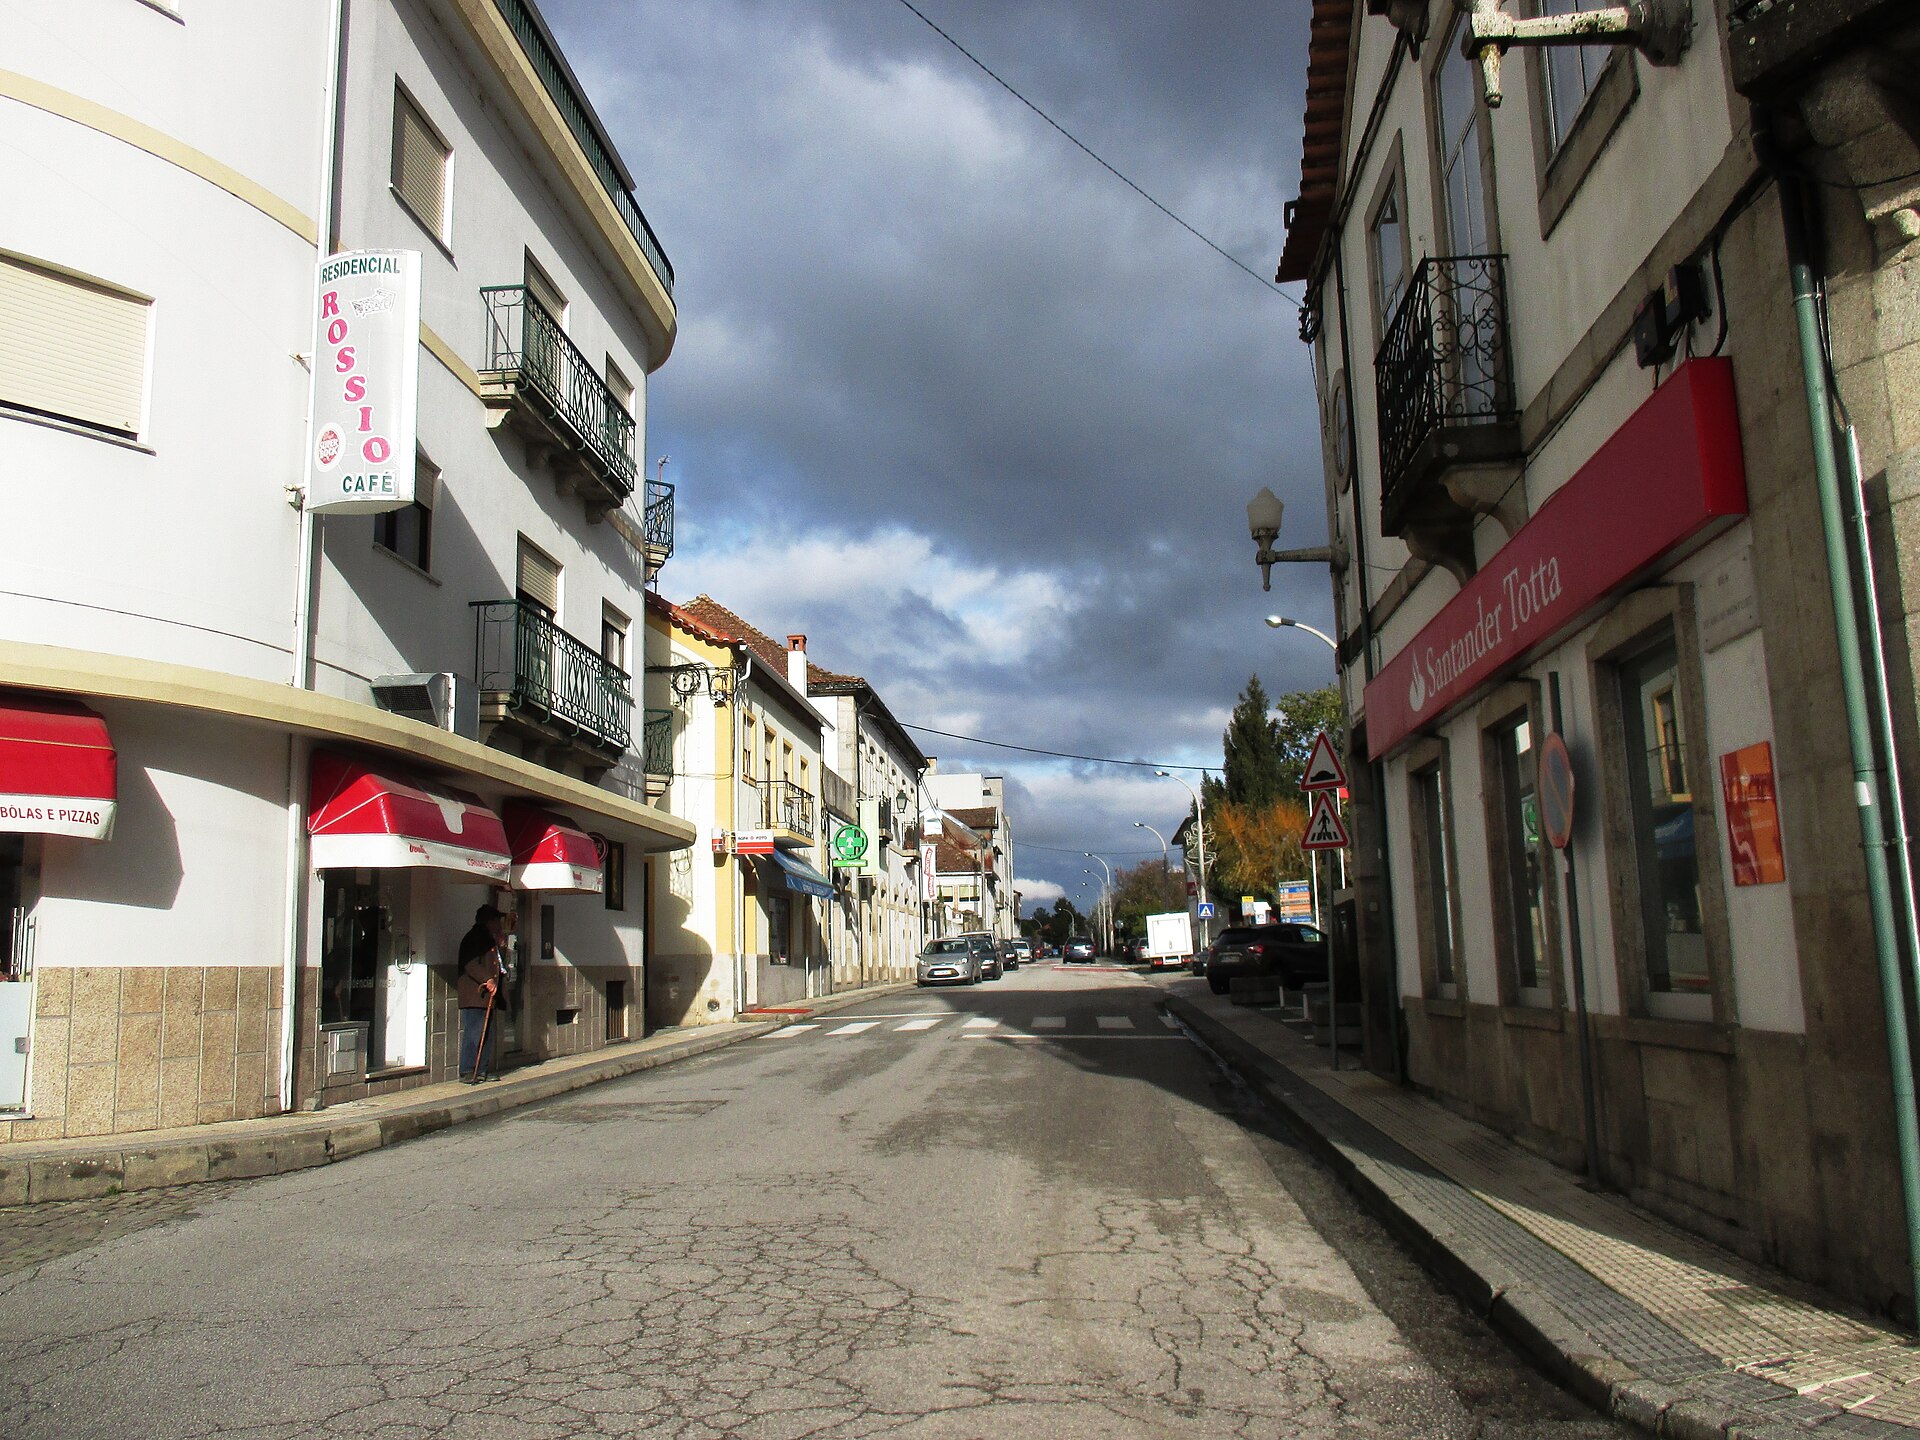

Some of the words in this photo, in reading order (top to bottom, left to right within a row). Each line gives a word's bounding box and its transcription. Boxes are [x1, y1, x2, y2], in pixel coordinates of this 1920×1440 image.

[321, 256, 400, 284] RESIDENCIAL
[321, 290, 391, 464] ROSSIO
[342, 471, 393, 493] CAFÉ
[1426, 595, 1503, 698] Santander
[1503, 556, 1562, 632] Totta
[47, 808, 55, 820] E
[59, 809, 100, 825] PIZZAS
